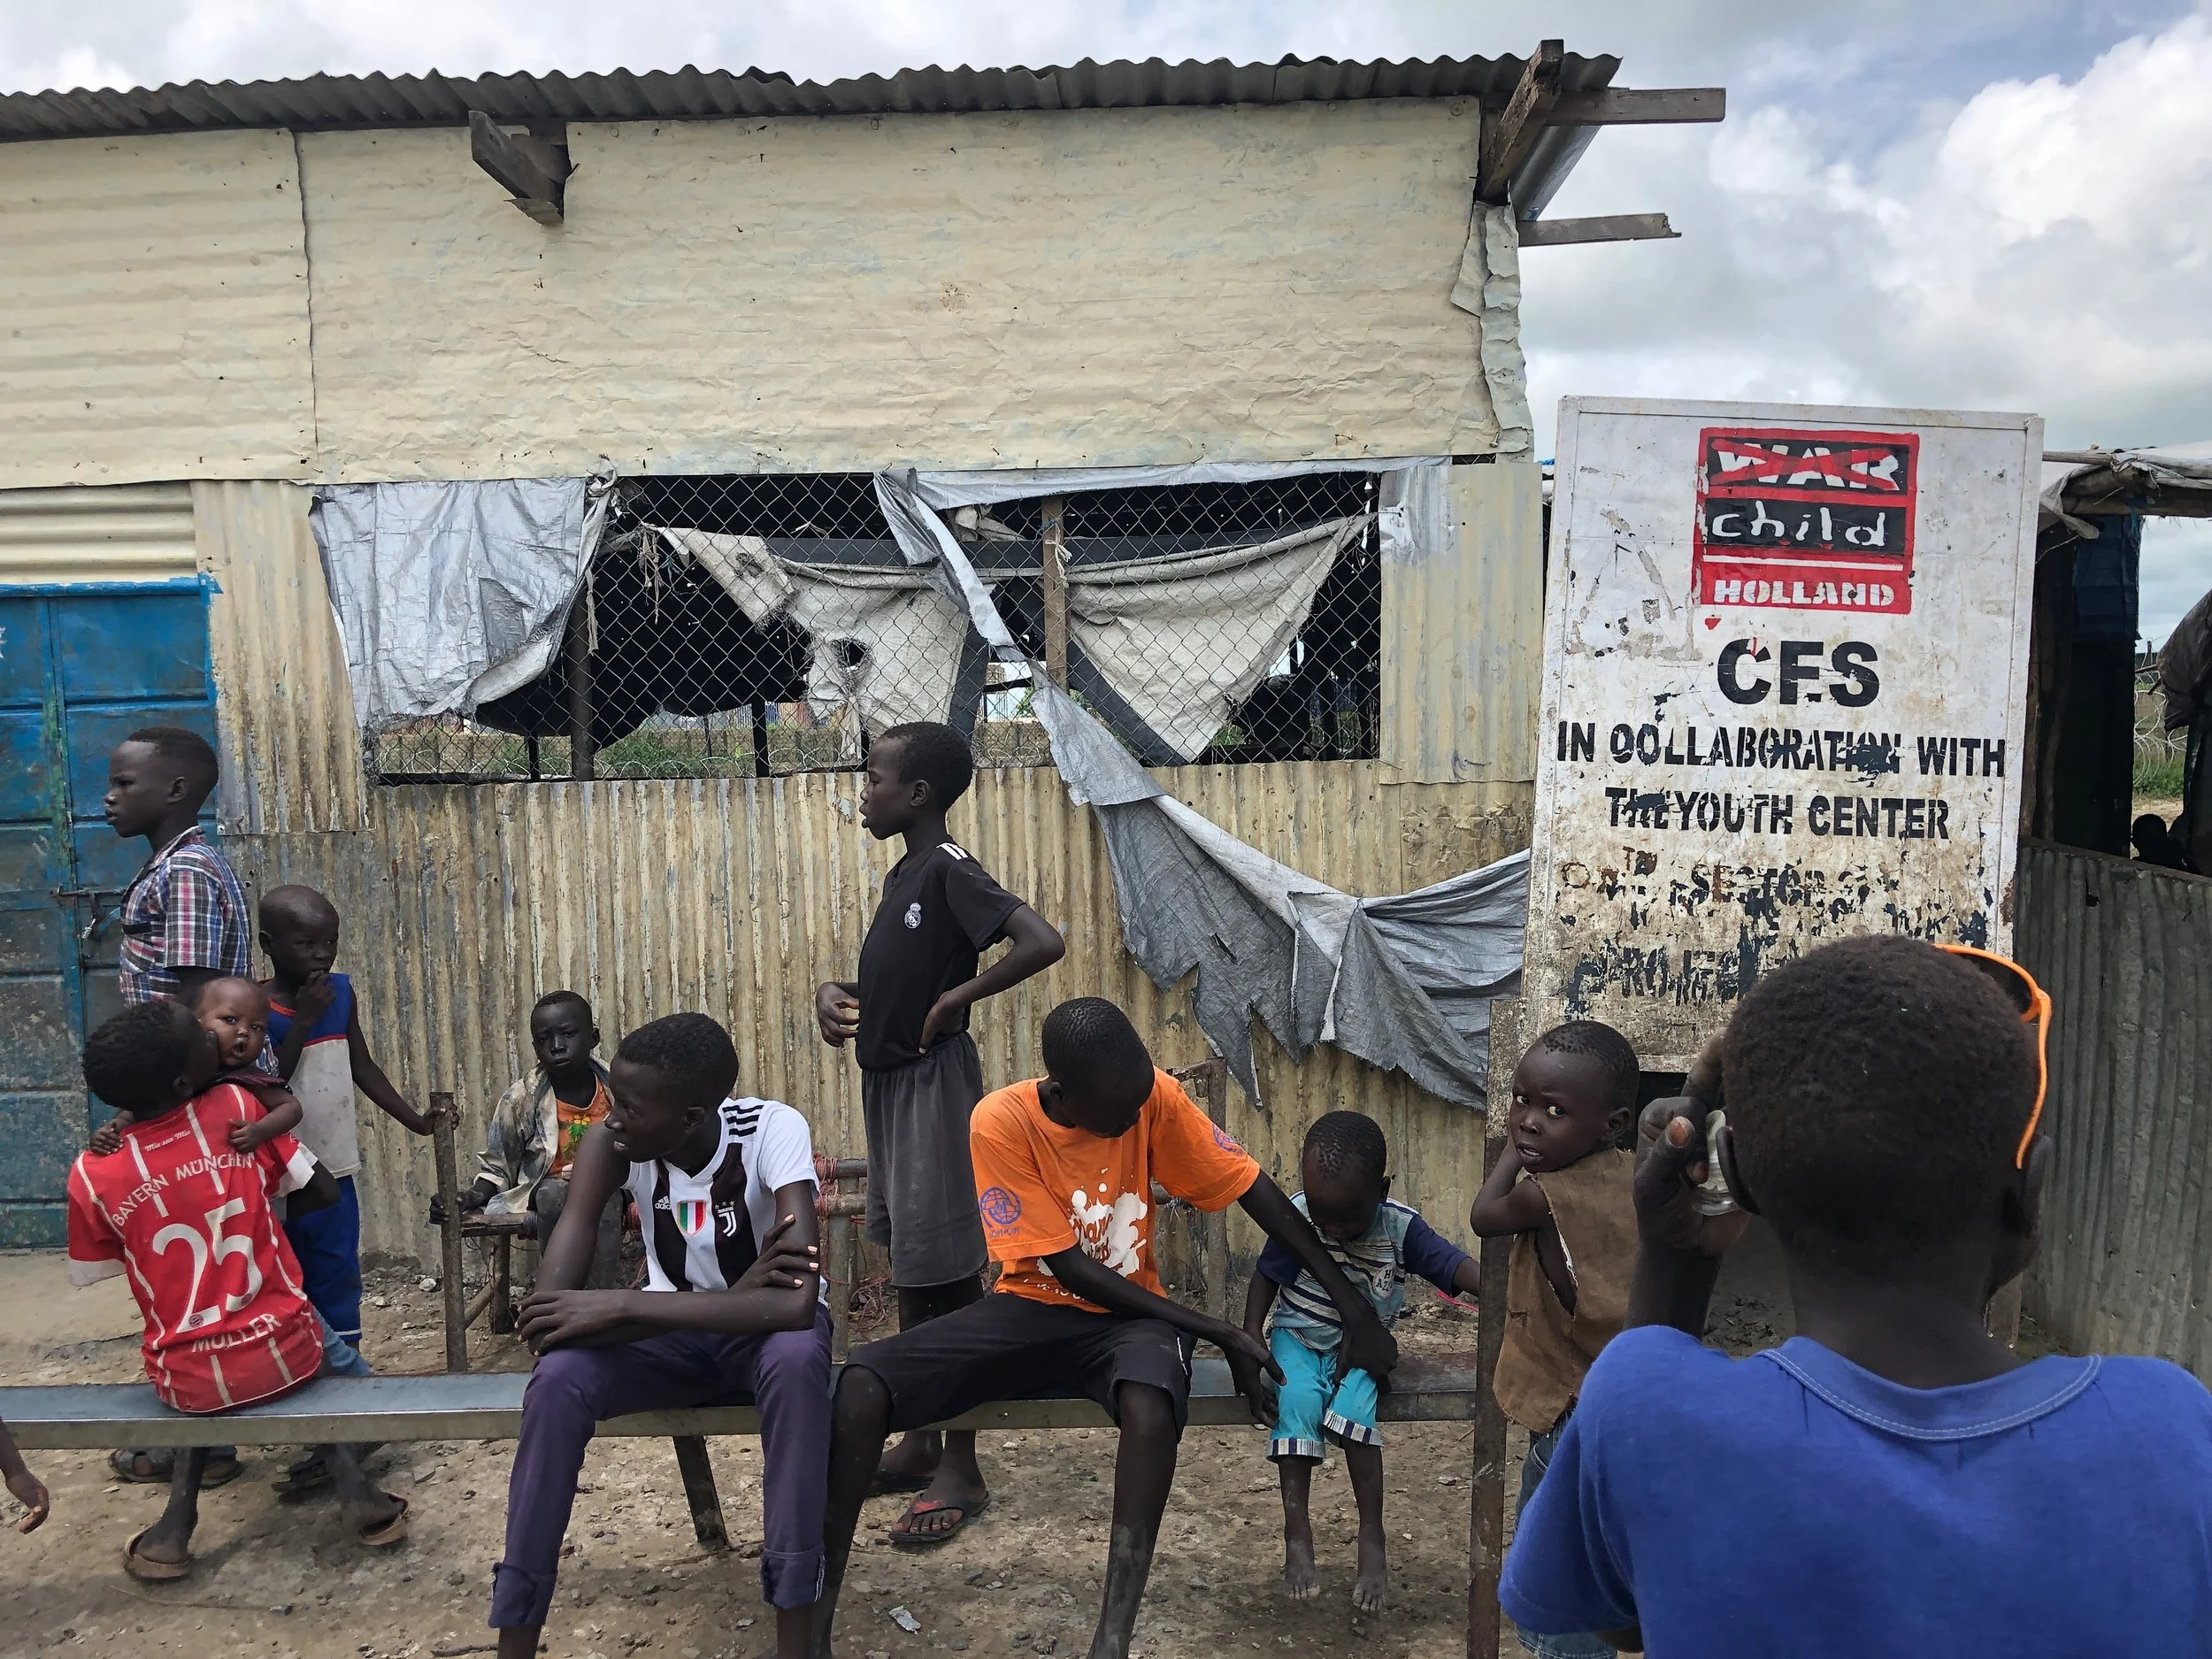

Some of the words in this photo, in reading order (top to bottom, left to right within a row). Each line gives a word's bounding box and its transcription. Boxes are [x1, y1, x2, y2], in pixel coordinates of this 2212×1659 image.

[1713, 442, 1900, 491] WAR
[1712, 500, 1886, 546] child
[1714, 580, 1894, 606] HOLLAND
[1717, 637, 1880, 707] CFS
[1557, 721, 1595, 762] IN
[1917, 736, 2006, 777] WITH
[1673, 791, 1793, 834] YOUTH
[1808, 795, 1950, 840] CENTER
[111, 1173, 170, 1226] BAYERN
[152, 1197, 263, 1333] 25
